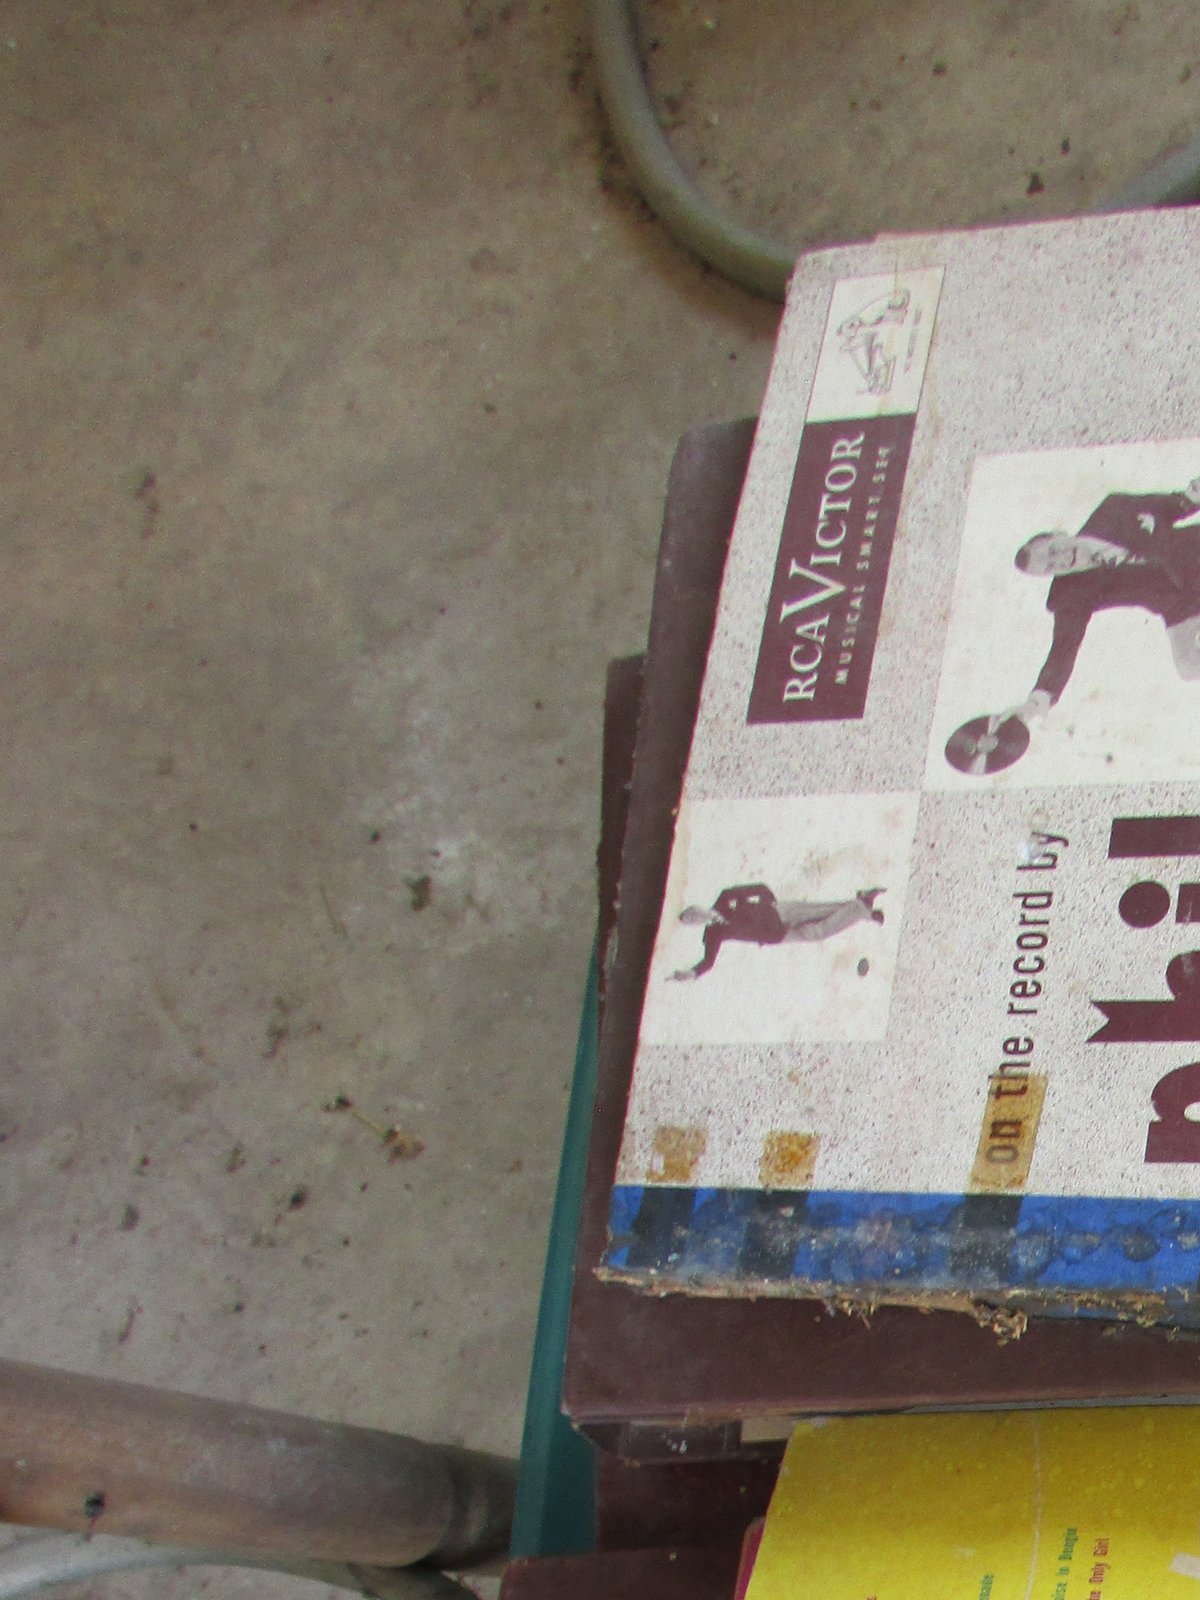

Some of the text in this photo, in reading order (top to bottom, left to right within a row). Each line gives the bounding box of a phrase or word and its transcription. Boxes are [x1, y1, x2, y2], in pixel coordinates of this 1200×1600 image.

[780, 430, 865, 701] RCA VICTOR
[834, 583, 867, 684] MUSICAL
[856, 493, 881, 570] SMART
[982, 829, 1069, 1163] on the record by
[1058, 1526, 1079, 1560] Boogie
[1091, 1536, 1110, 1556] Girl
[1055, 1565, 1071, 1575] in
[1088, 1561, 1111, 1583] Only
